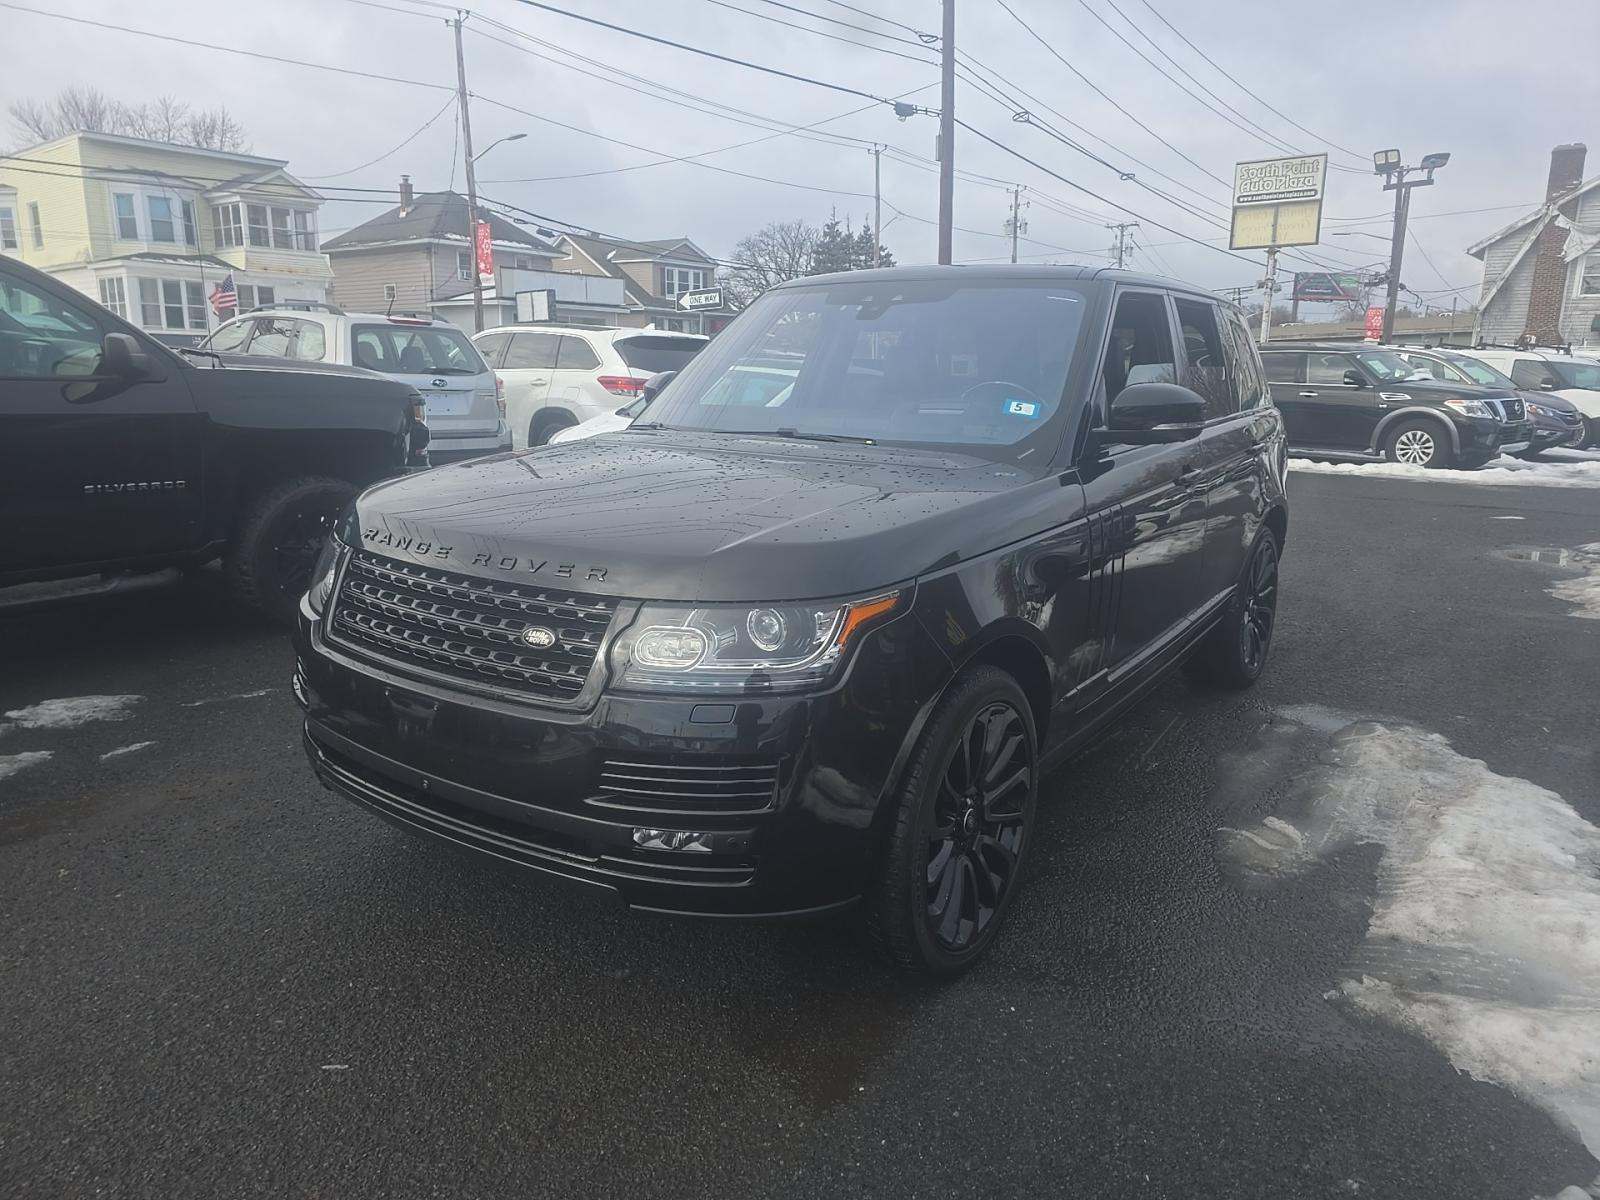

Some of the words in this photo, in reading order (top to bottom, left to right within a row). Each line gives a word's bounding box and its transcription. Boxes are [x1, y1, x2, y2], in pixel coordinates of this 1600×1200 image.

[1239, 164, 1279, 180] South
[1281, 159, 1320, 177] Point
[1239, 178, 1274, 193] Auto
[1274, 175, 1317, 190] Plaza
[689, 295, 703, 304] ONE
[704, 294, 717, 303] WAY
[1013, 402, 1023, 411] 5
[83, 480, 187, 494] SILVERADO
[361, 527, 453, 559] RANGE
[471, 552, 609, 583] ROVER
[529, 630, 546, 638] LAND
[529, 636, 549, 645] ROVER
